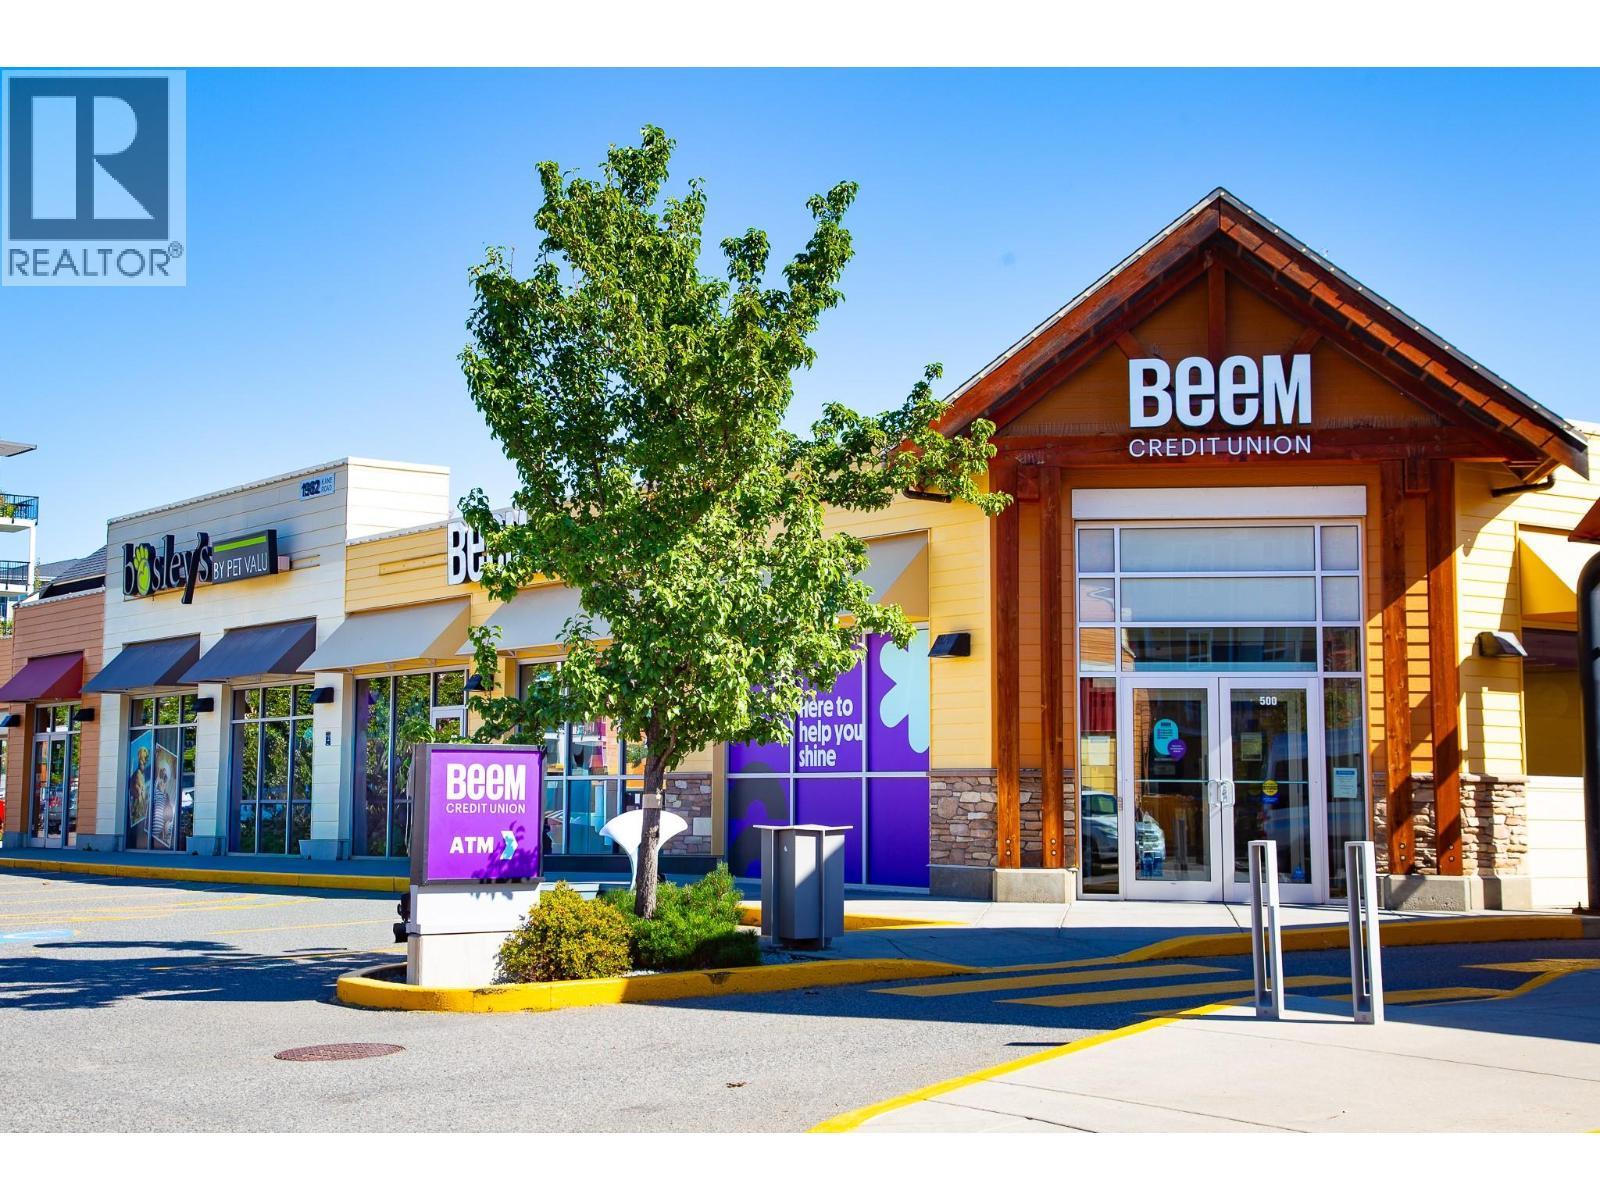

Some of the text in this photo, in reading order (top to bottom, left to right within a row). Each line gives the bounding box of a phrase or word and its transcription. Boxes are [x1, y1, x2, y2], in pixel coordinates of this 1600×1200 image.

[1129, 435, 1311, 457] CREDIT UNION
[213, 552, 268, 580] BY PET VALU
[836, 696, 853, 717] to
[1259, 696, 1277, 706] 500
[799, 720, 865, 746] help you
[799, 744, 837, 767] shine
[446, 803, 526, 814] CREDIT UNION
[449, 836, 494, 854] ATM
